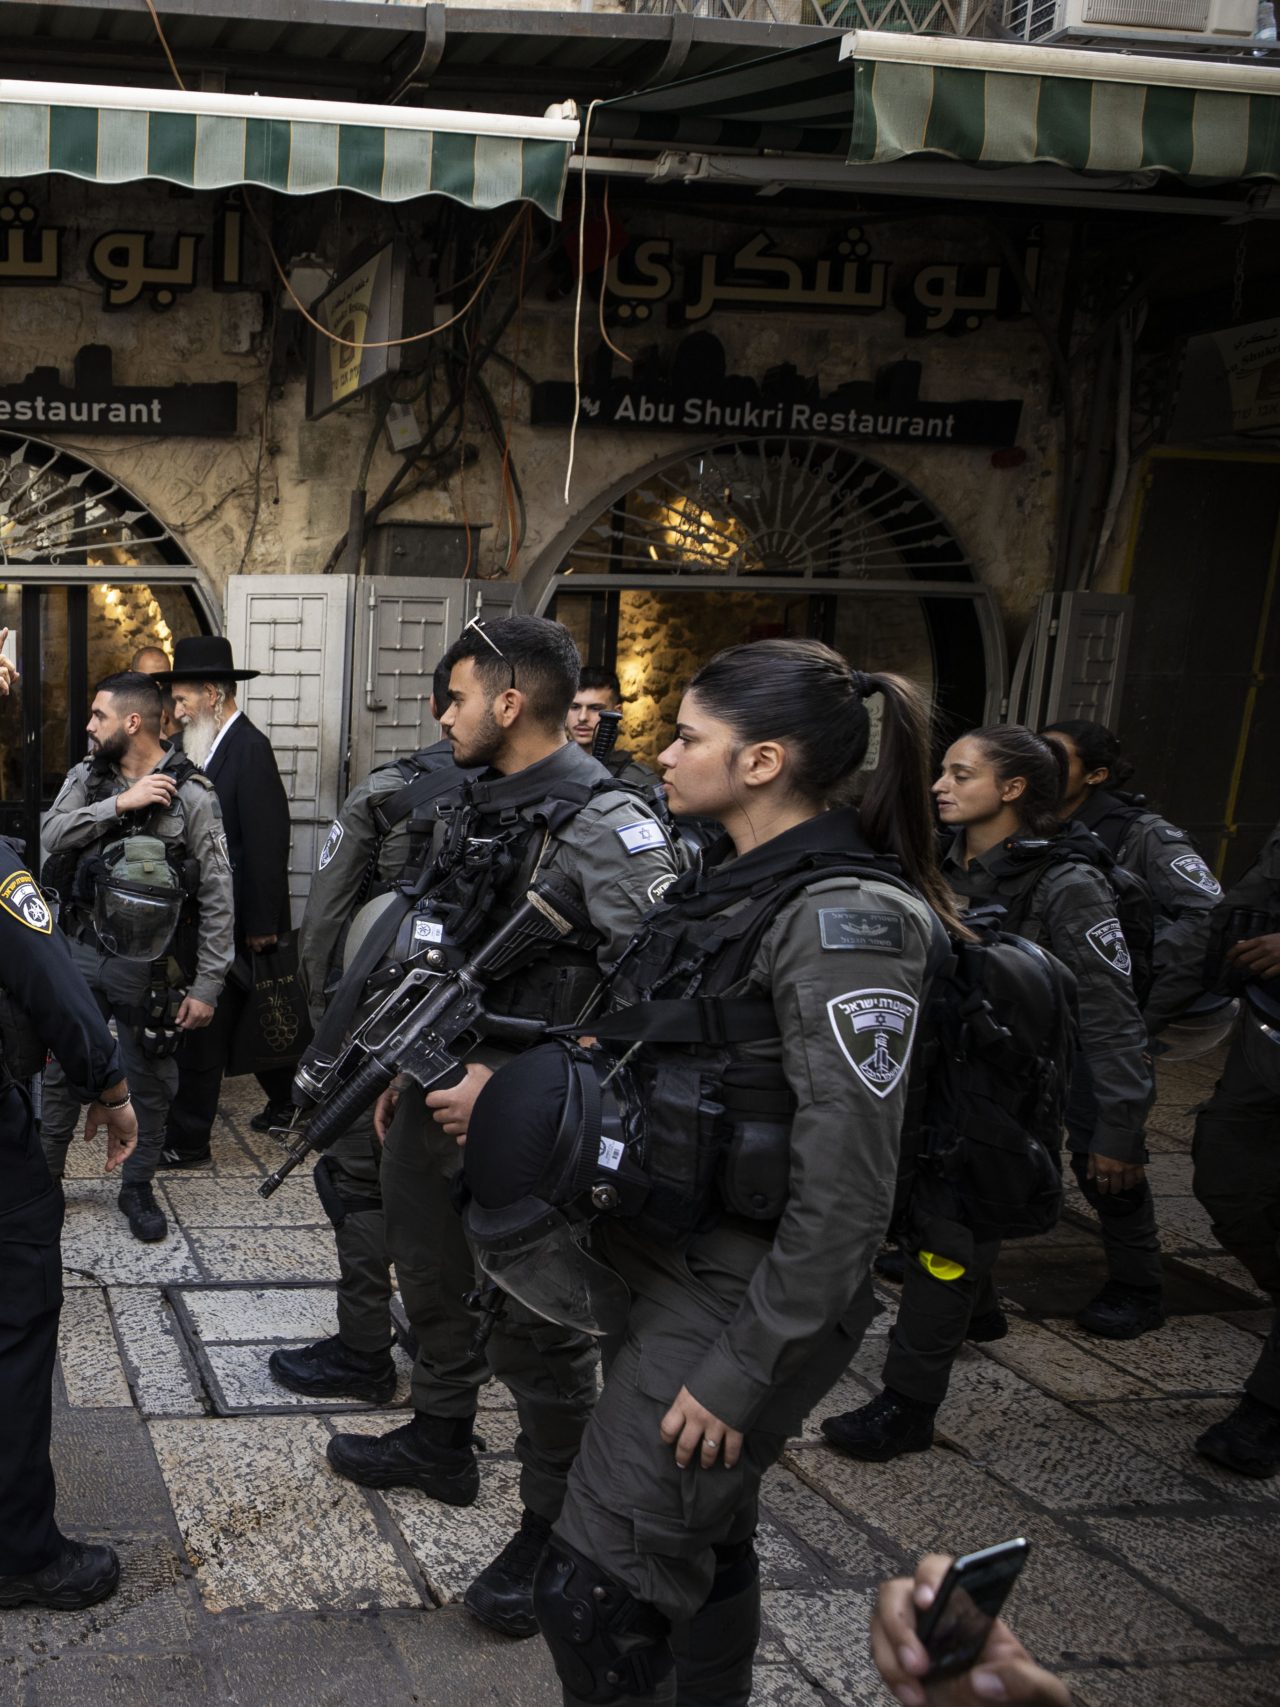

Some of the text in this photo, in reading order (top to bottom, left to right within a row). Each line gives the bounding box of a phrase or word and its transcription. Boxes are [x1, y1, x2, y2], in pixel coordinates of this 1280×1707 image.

[603, 227, 887, 320] شكري
[613, 394, 956, 438] Abu Shukri Restaurant
[838, 997, 913, 1017] משטרת ישראל
